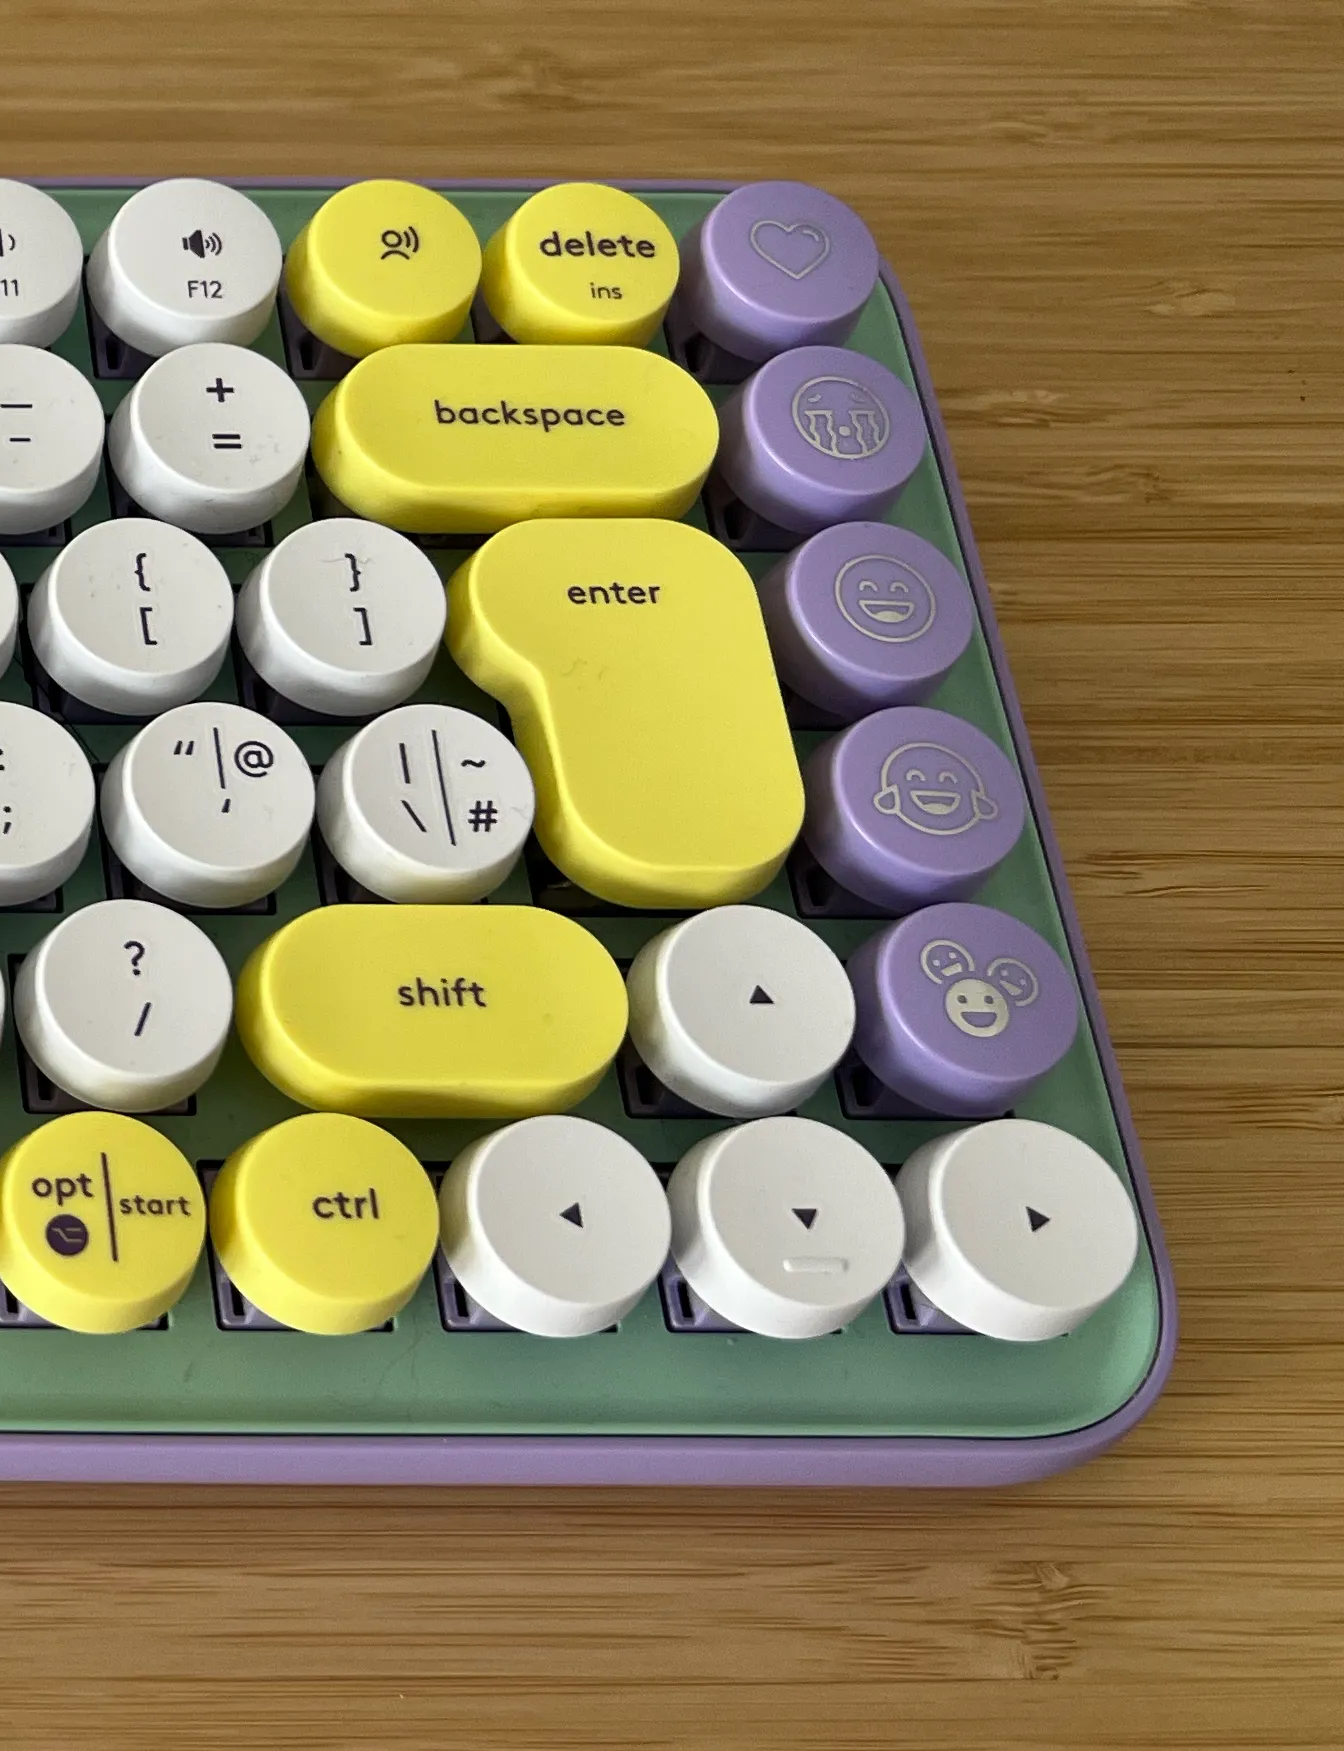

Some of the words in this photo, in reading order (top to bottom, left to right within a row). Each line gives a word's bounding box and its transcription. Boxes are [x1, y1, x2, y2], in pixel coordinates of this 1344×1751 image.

[539, 230, 656, 259] delete
[187, 279, 223, 299] F12
[589, 281, 623, 300] ins
[434, 399, 625, 433] backspace
[567, 582, 661, 605] enter
[397, 976, 487, 1008] shift
[31, 1173, 94, 1207] opt
[312, 1187, 380, 1220] ctrl
[119, 1194, 191, 1217] start
